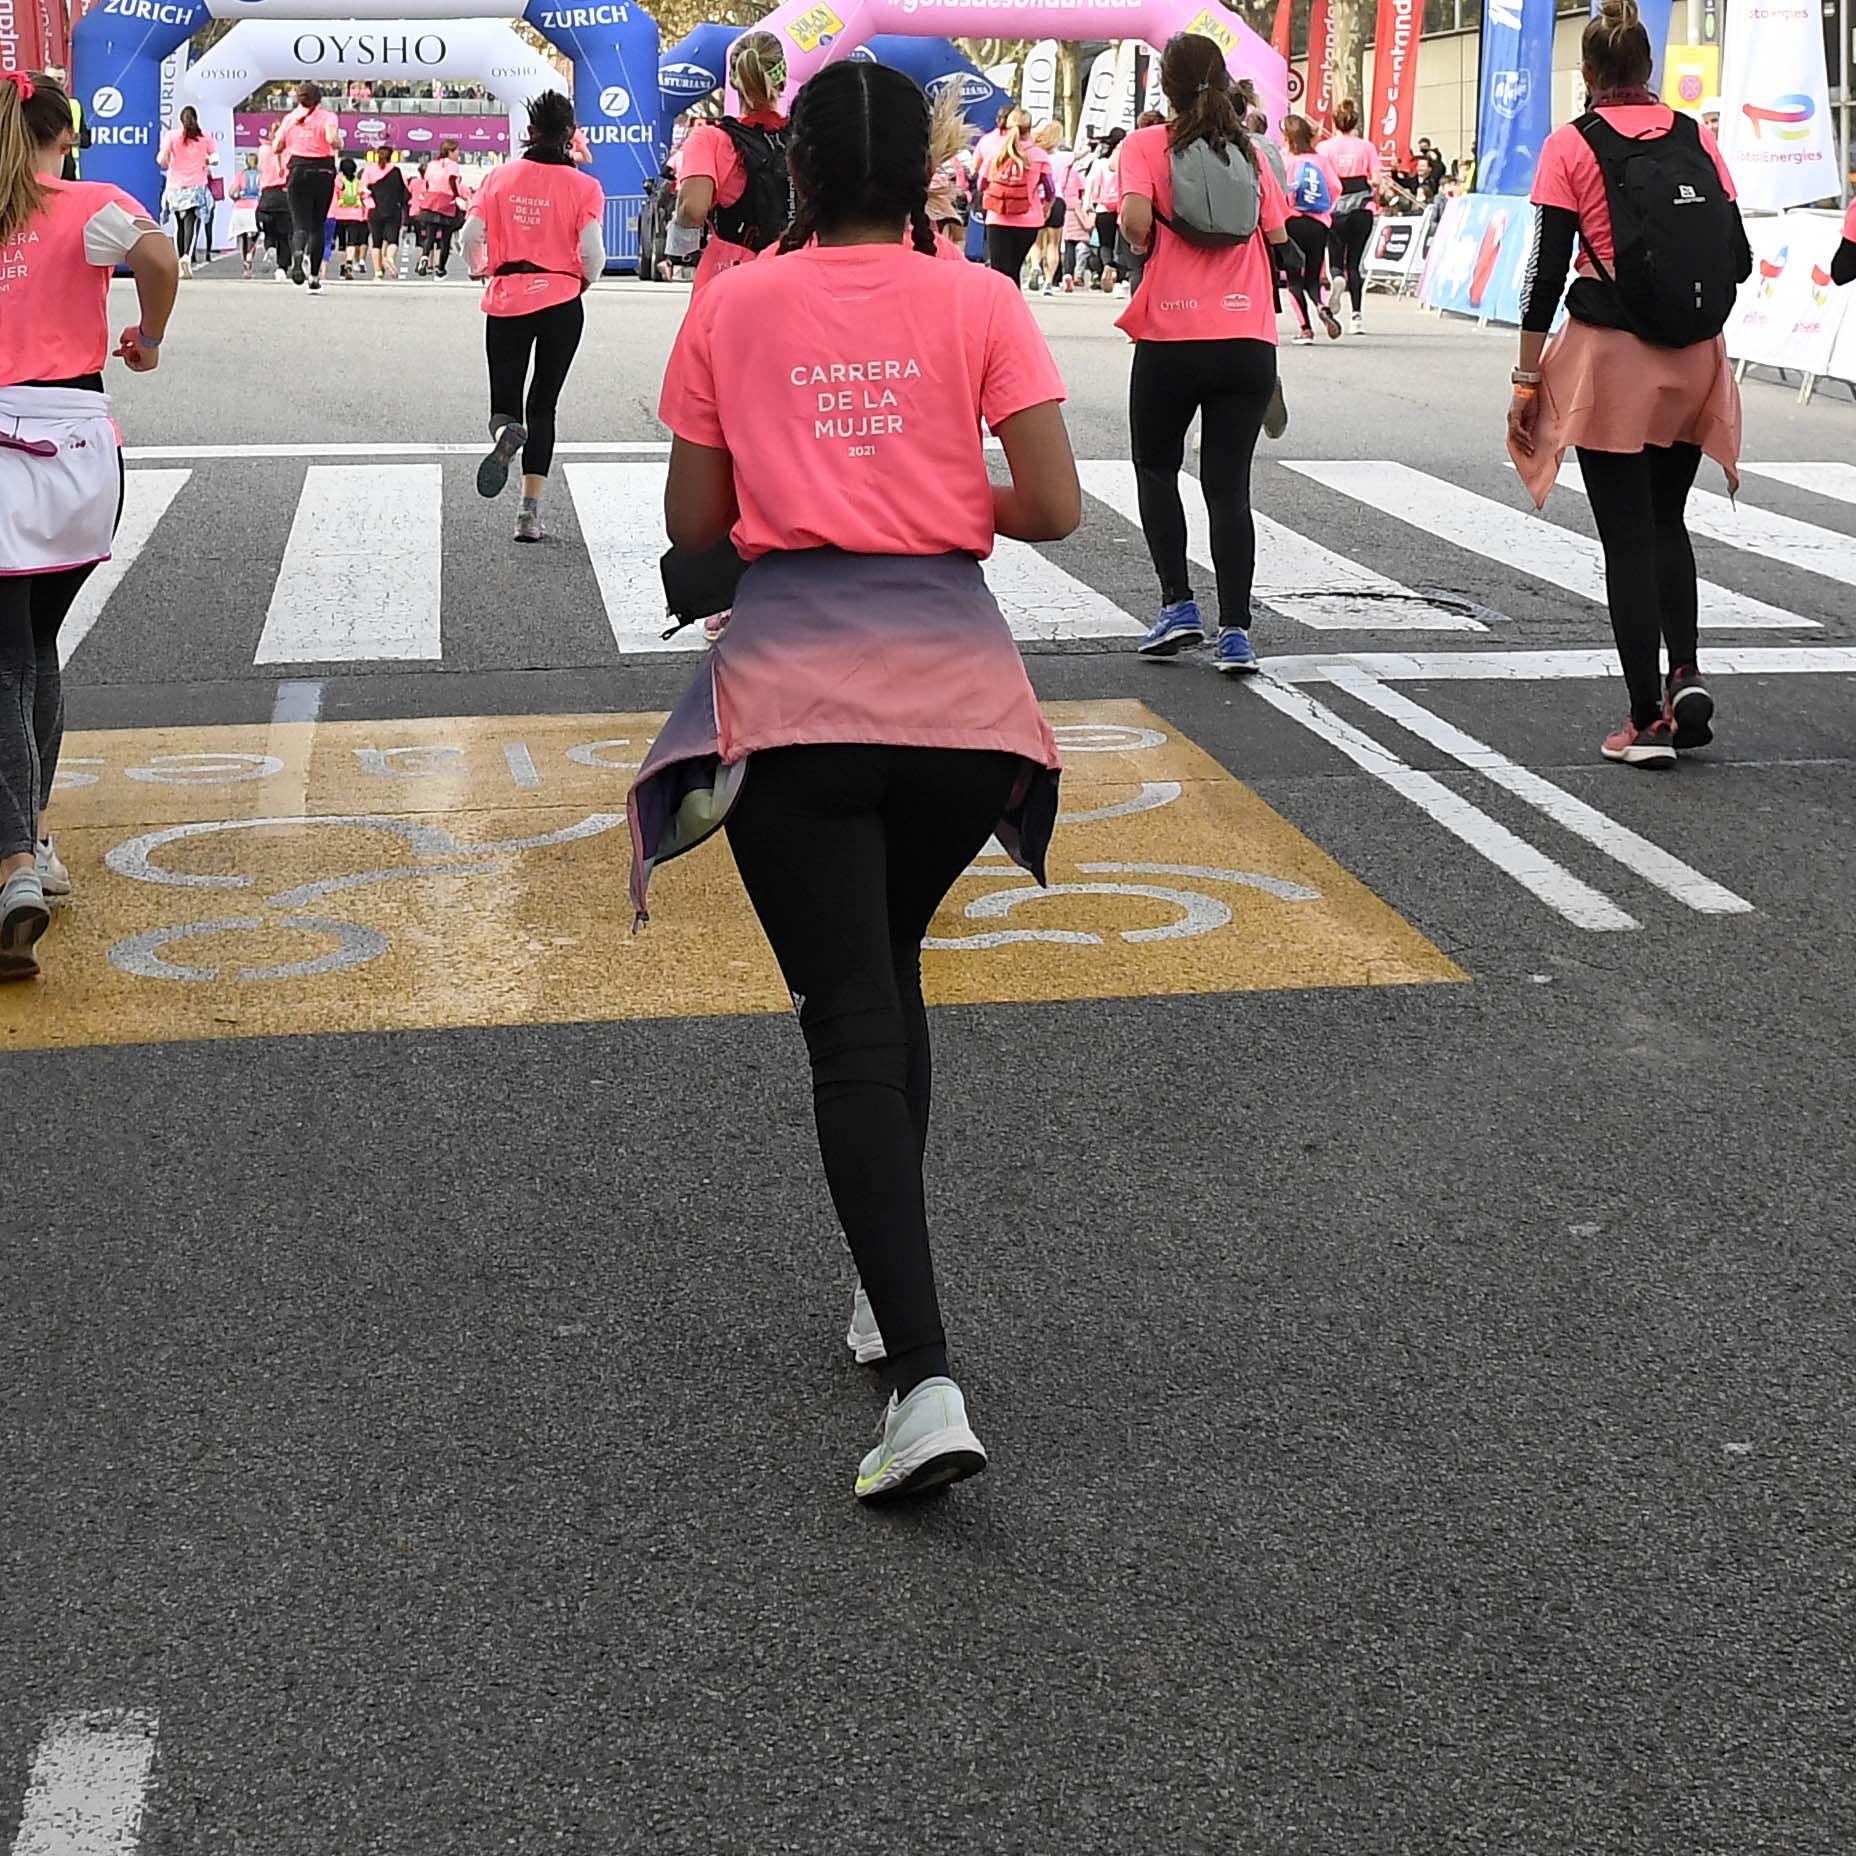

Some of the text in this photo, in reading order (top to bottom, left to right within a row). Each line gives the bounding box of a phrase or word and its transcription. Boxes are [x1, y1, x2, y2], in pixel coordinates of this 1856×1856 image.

[541, 5, 630, 29] ZURICH
[293, 33, 448, 66] OYSHO
[200, 69, 248, 80] OYSHO
[491, 65, 538, 79] OYSHO
[90, 125, 149, 145] URICH
[3, 249, 25, 264] LA
[790, 358, 922, 386] CARRERA
[817, 388, 898, 412] DE LA
[814, 414, 904, 439] MUJER
[847, 445, 876, 457] 2021
